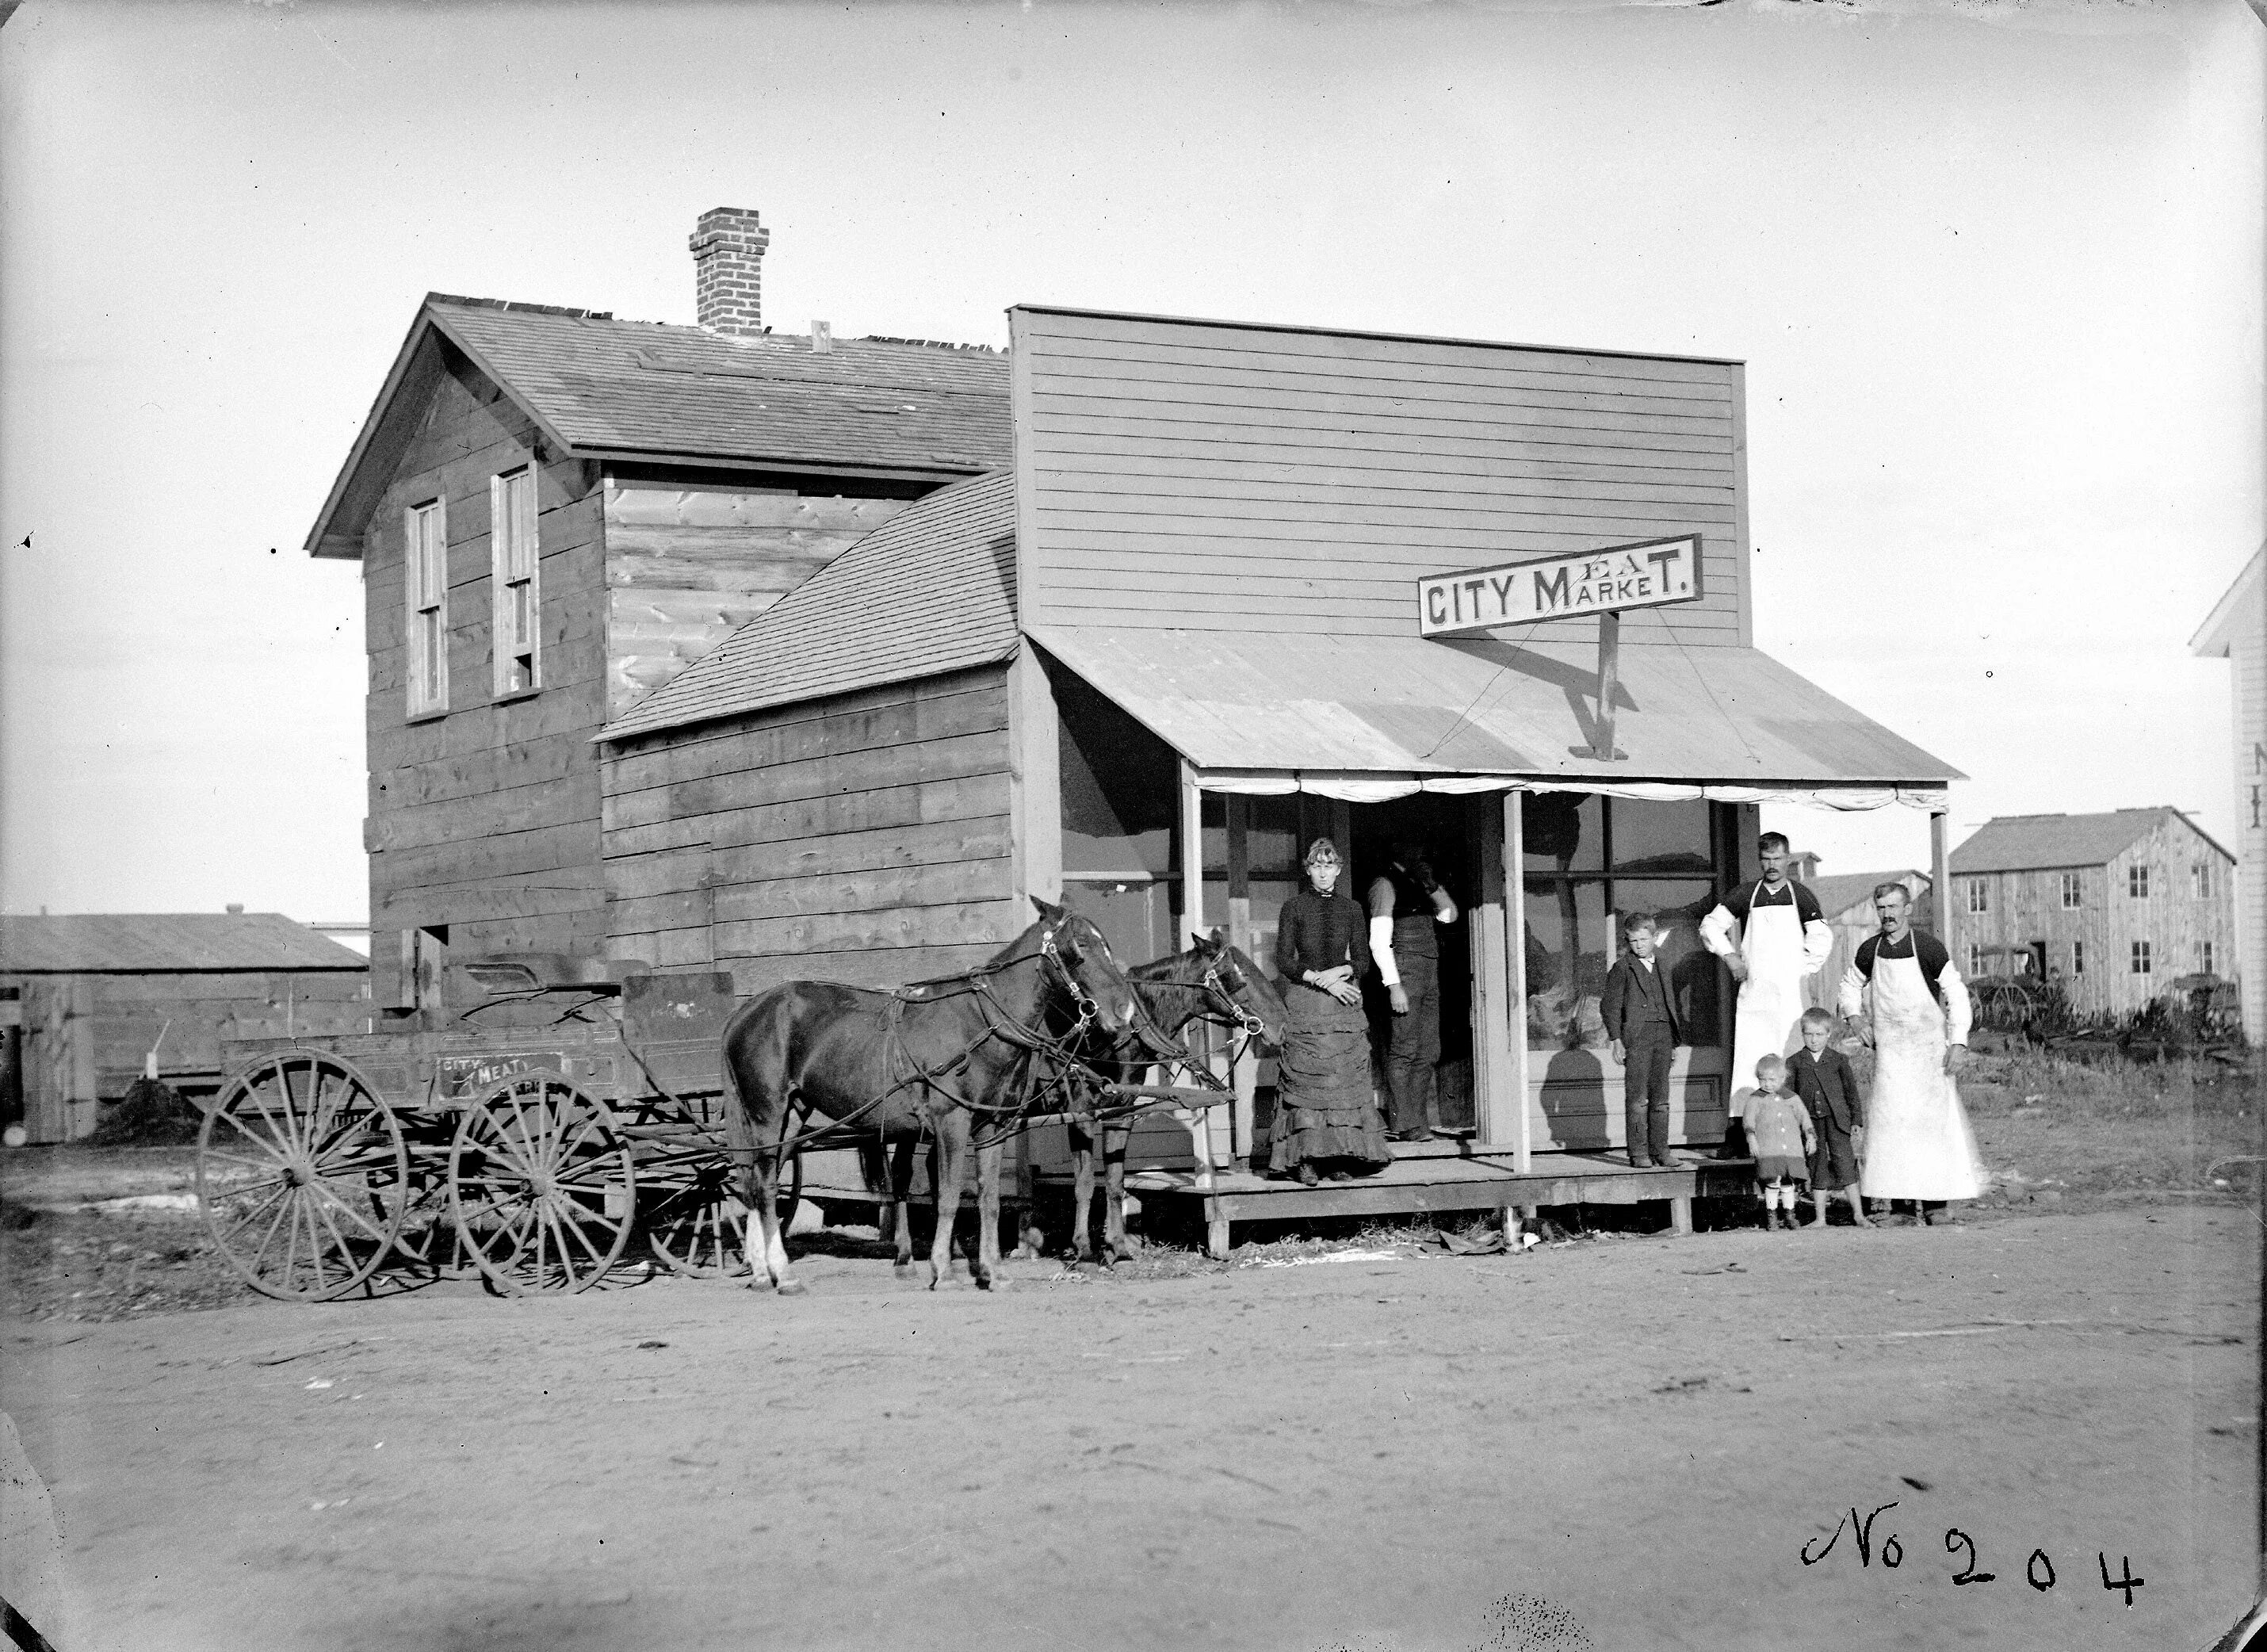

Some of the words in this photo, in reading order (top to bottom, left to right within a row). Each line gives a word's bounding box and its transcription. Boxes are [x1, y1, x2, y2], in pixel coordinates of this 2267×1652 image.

[1428, 575, 1515, 626] CITY
[442, 1058, 484, 1071] CITY
[478, 1059, 520, 1085] MEAT
